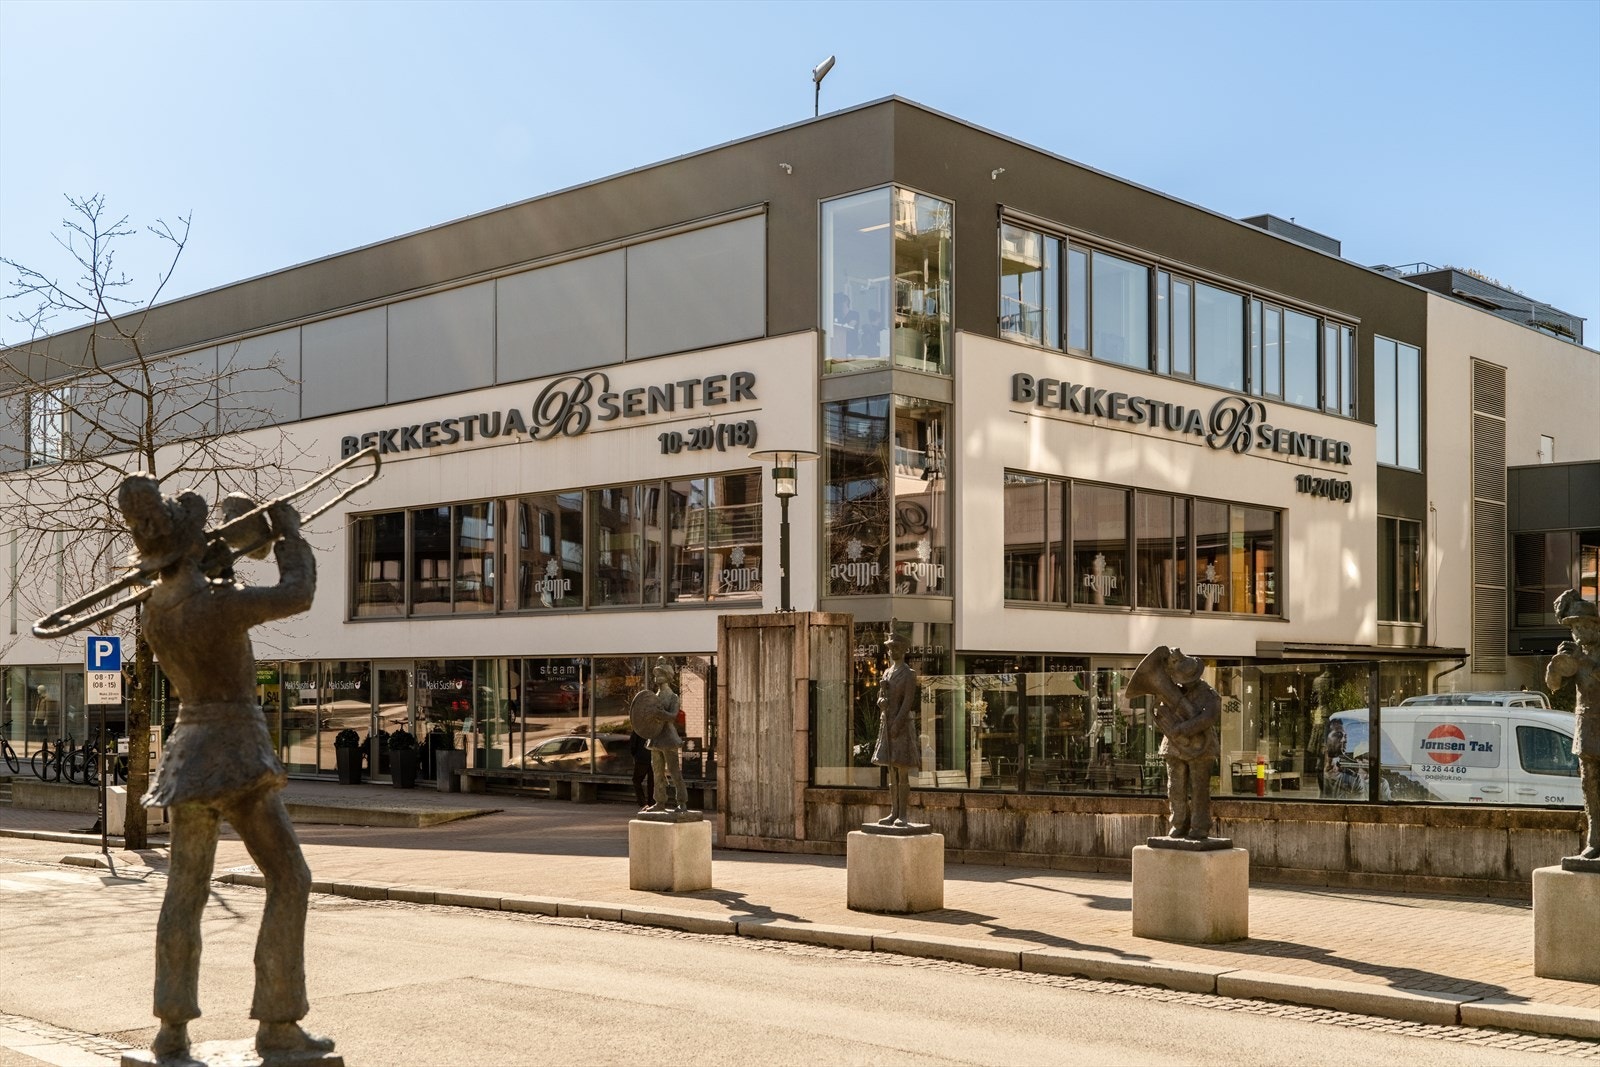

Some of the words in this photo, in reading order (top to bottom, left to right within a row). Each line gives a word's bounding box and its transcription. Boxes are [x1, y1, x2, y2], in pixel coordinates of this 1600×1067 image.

[341, 408, 526, 460] BEKKESTUA
[597, 371, 757, 422] SENTER
[1012, 372, 1206, 437] BEKKESTUA
[1258, 424, 1352, 466] SENTER
[95, 640, 114, 667] P
[540, 664, 575, 675] steam
[328, 680, 340, 690] Maki
[341, 680, 354, 690] Sushi
[426, 680, 439, 690] Maki
[440, 679, 455, 690] Sushi
[1469, 741, 1493, 752] Tak
